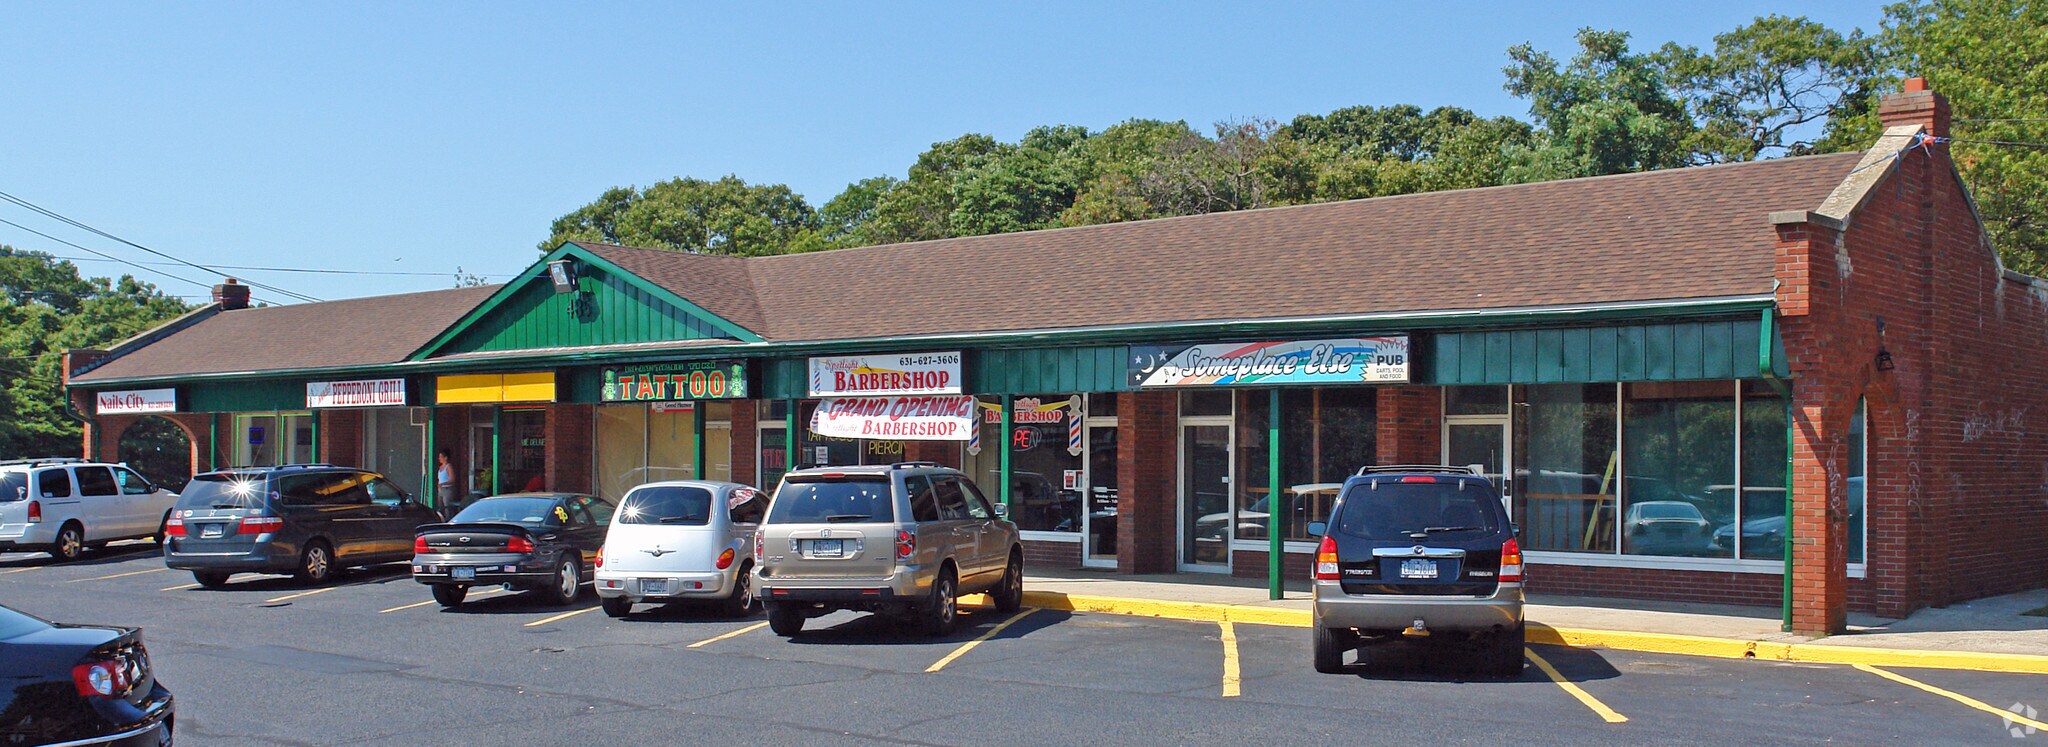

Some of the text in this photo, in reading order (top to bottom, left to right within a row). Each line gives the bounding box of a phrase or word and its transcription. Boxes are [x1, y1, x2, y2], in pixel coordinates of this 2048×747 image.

[899, 356, 959, 366] 631-627-3606
[1182, 344, 1353, 382] Someplace Else
[1376, 354, 1404, 366] PUB
[618, 370, 726, 400] TATTOO
[834, 370, 950, 392] BARBERSHOP
[100, 394, 124, 409] Nails
[125, 393, 145, 411] City
[332, 382, 376, 405] PEPPERONI
[378, 380, 403, 403] GRILL
[829, 395, 972, 421] GRAND OPENING
[986, 410, 1061, 422] BABERSHOP
[861, 420, 957, 436] BARBERSHOP
[1013, 429, 1039, 448] PEN
